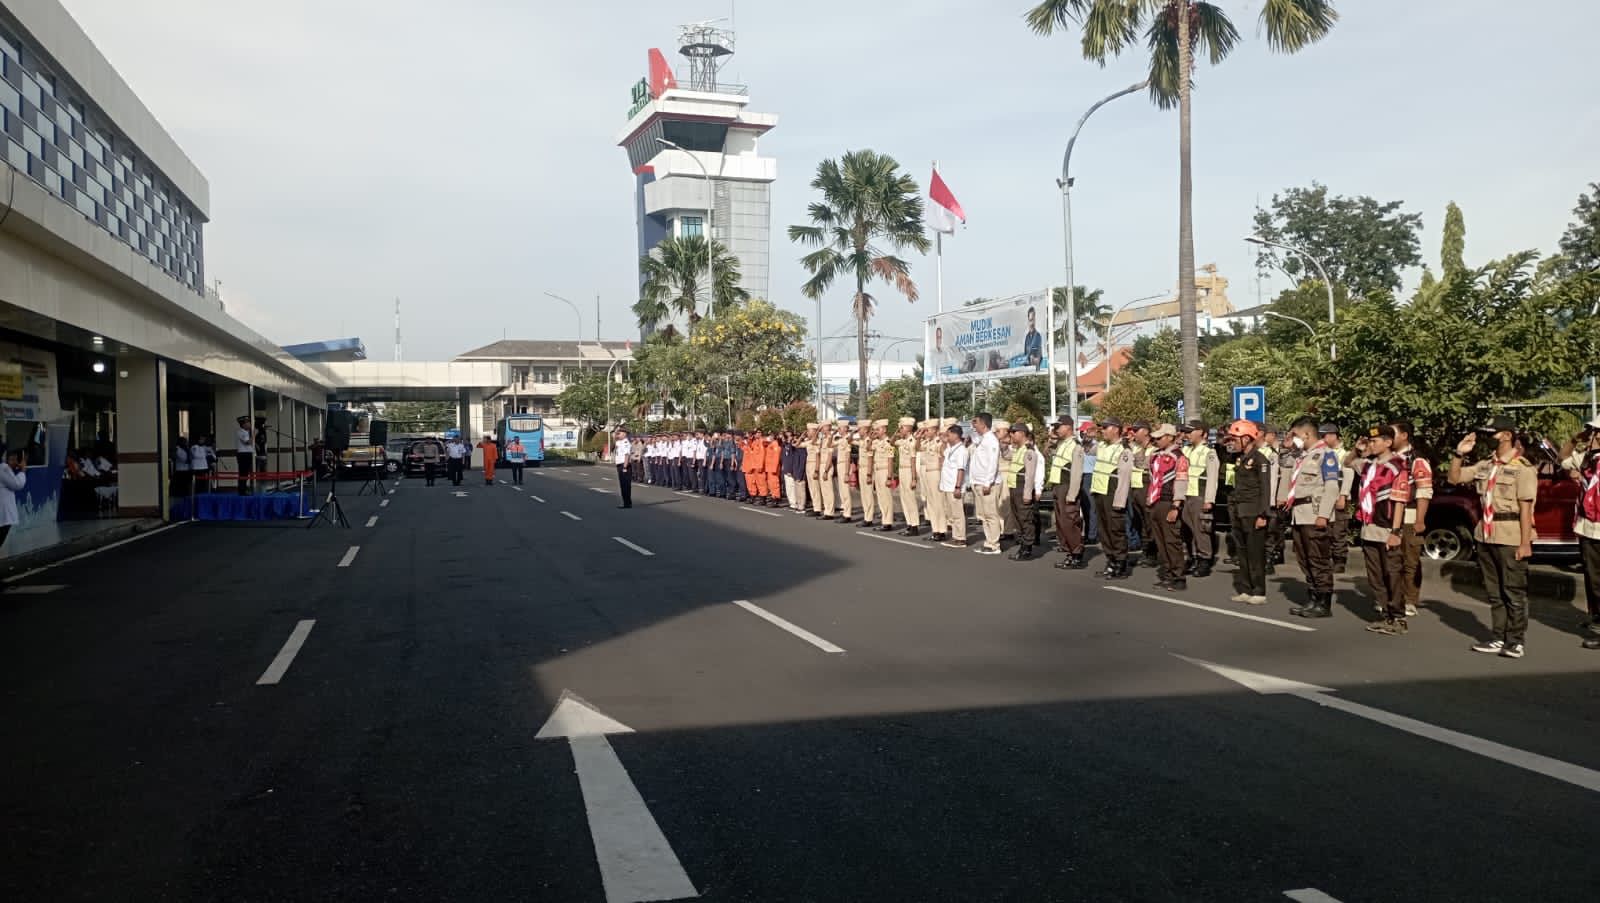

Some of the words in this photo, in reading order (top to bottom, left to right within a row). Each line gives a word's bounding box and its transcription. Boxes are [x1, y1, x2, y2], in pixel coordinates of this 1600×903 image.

[970, 317, 992, 332] MUDIK
[955, 333, 975, 347] AMAN
[975, 325, 1012, 343] BERKESAN
[1239, 392, 1259, 420] P
